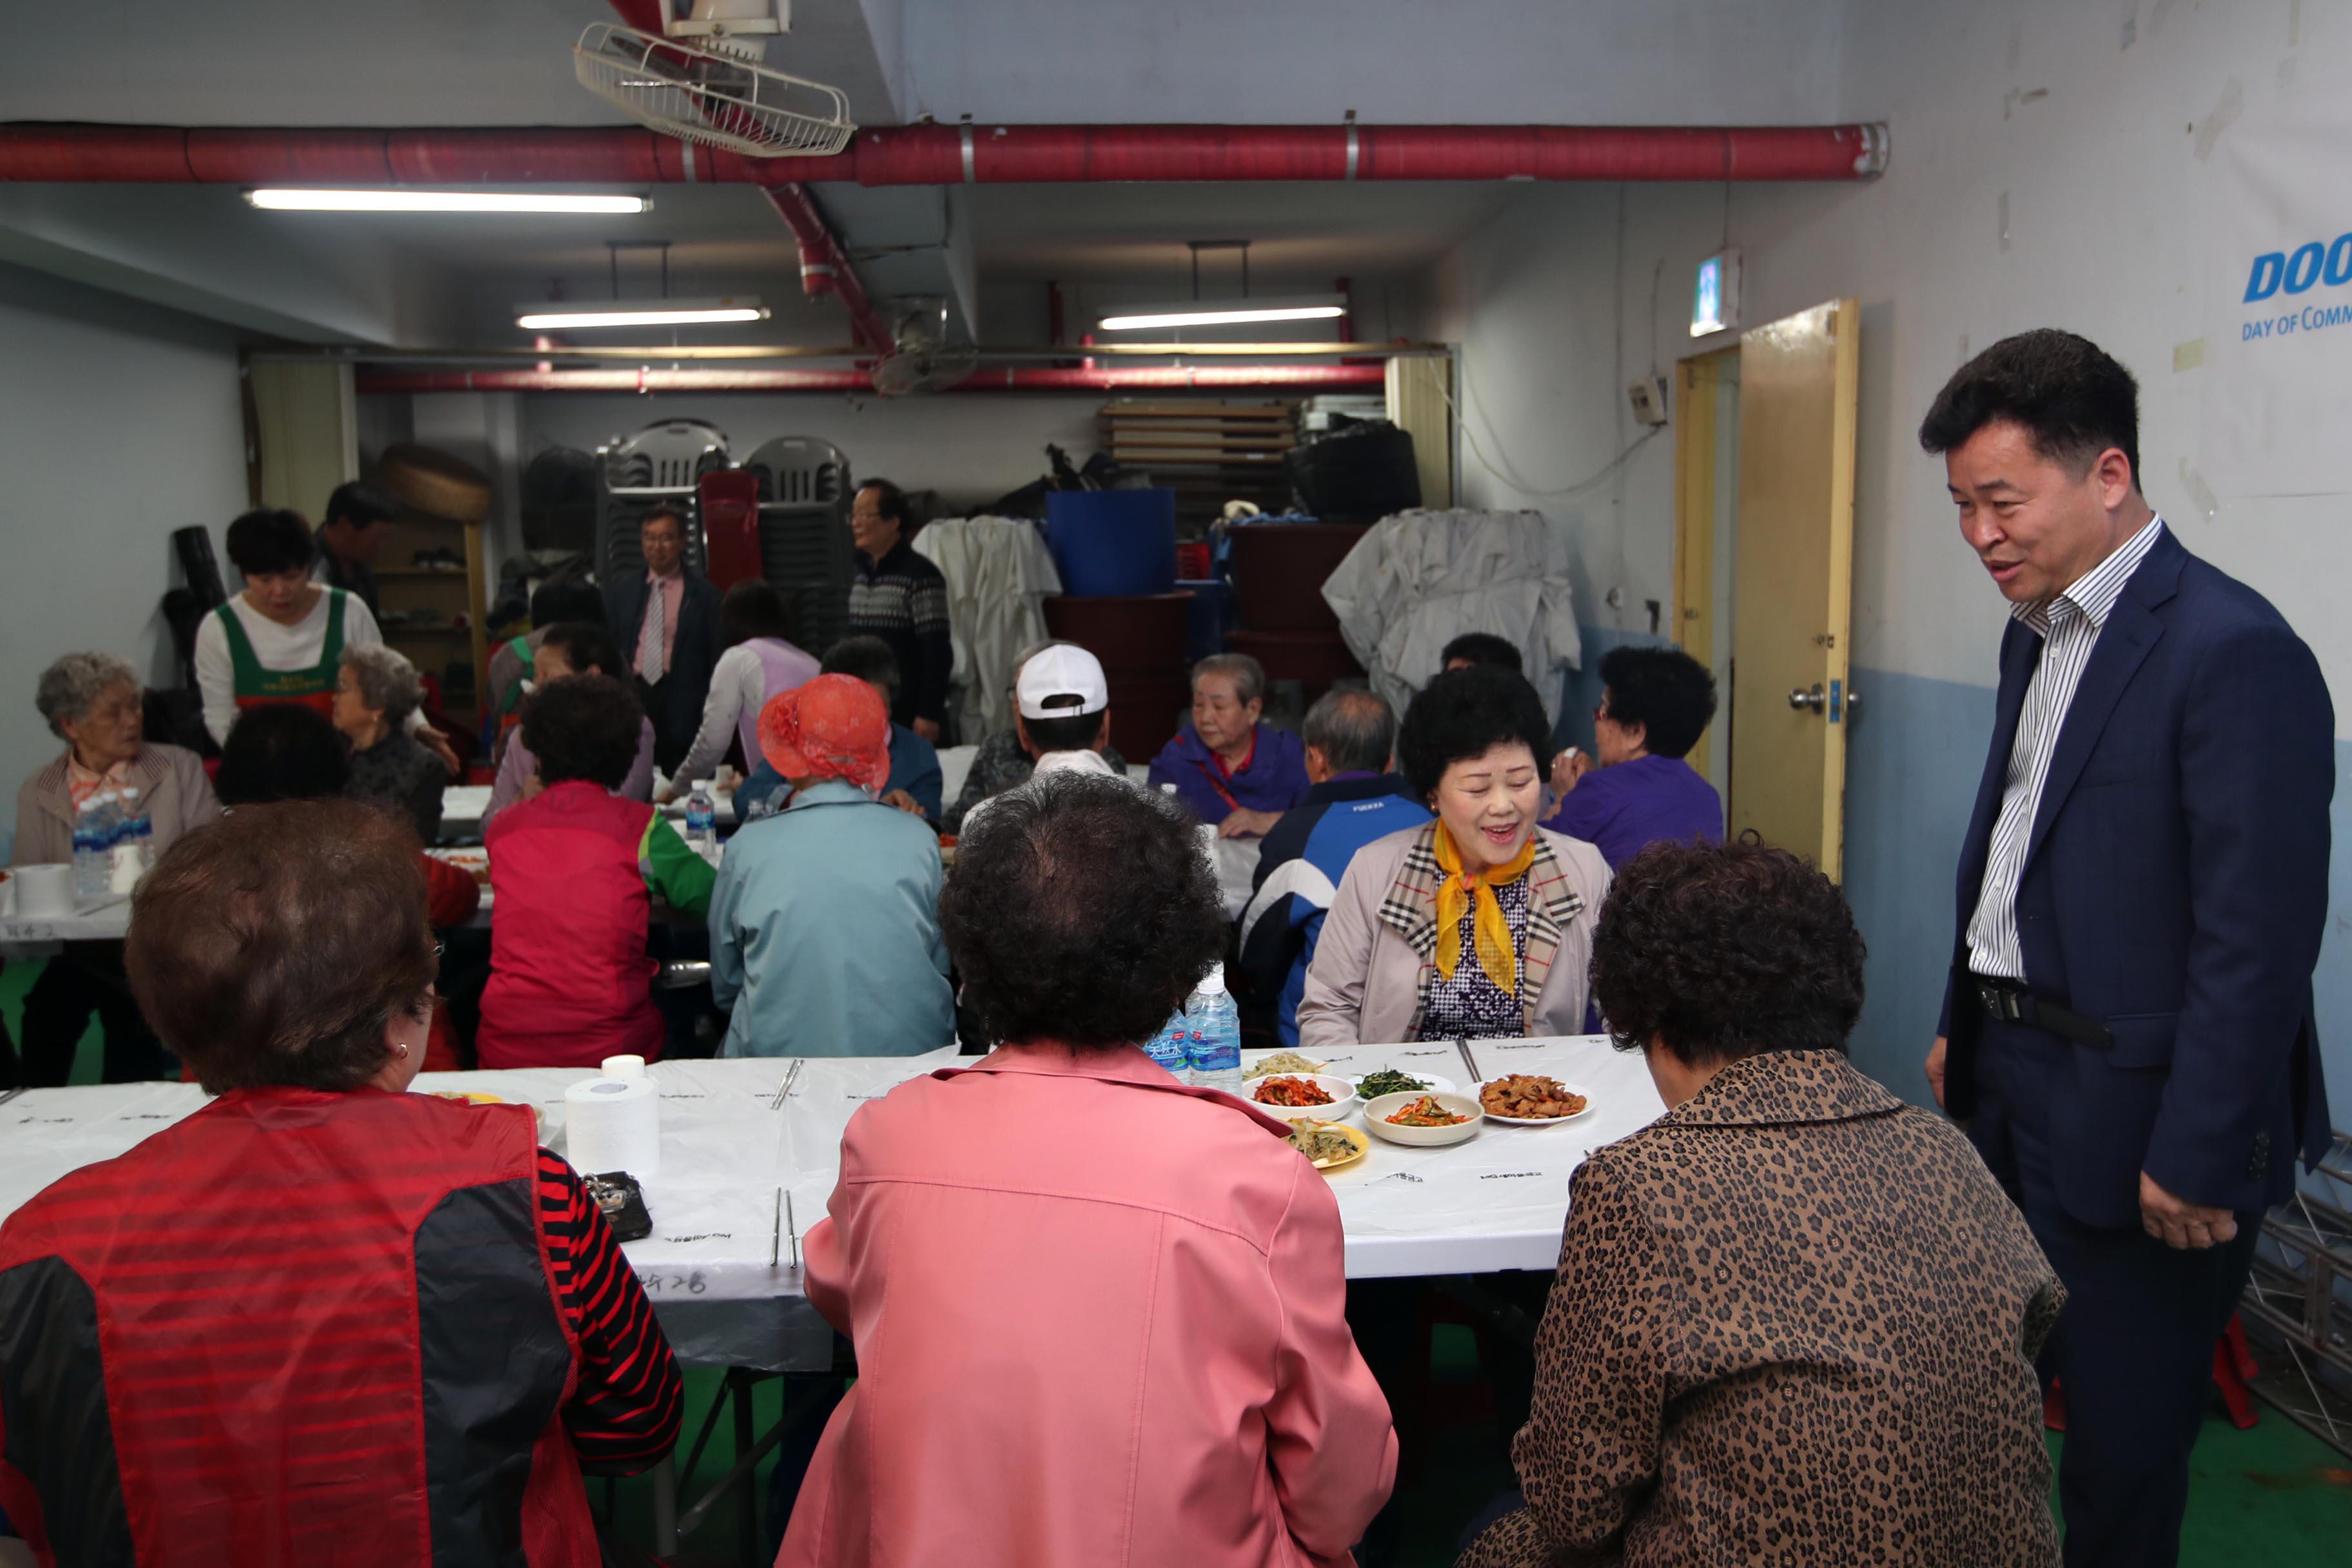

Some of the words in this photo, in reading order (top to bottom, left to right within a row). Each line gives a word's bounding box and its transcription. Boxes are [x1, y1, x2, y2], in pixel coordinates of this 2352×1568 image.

[2242, 231, 2352, 303] DOO
[2242, 318, 2274, 342] DAY
[2277, 314, 2298, 335] OF
